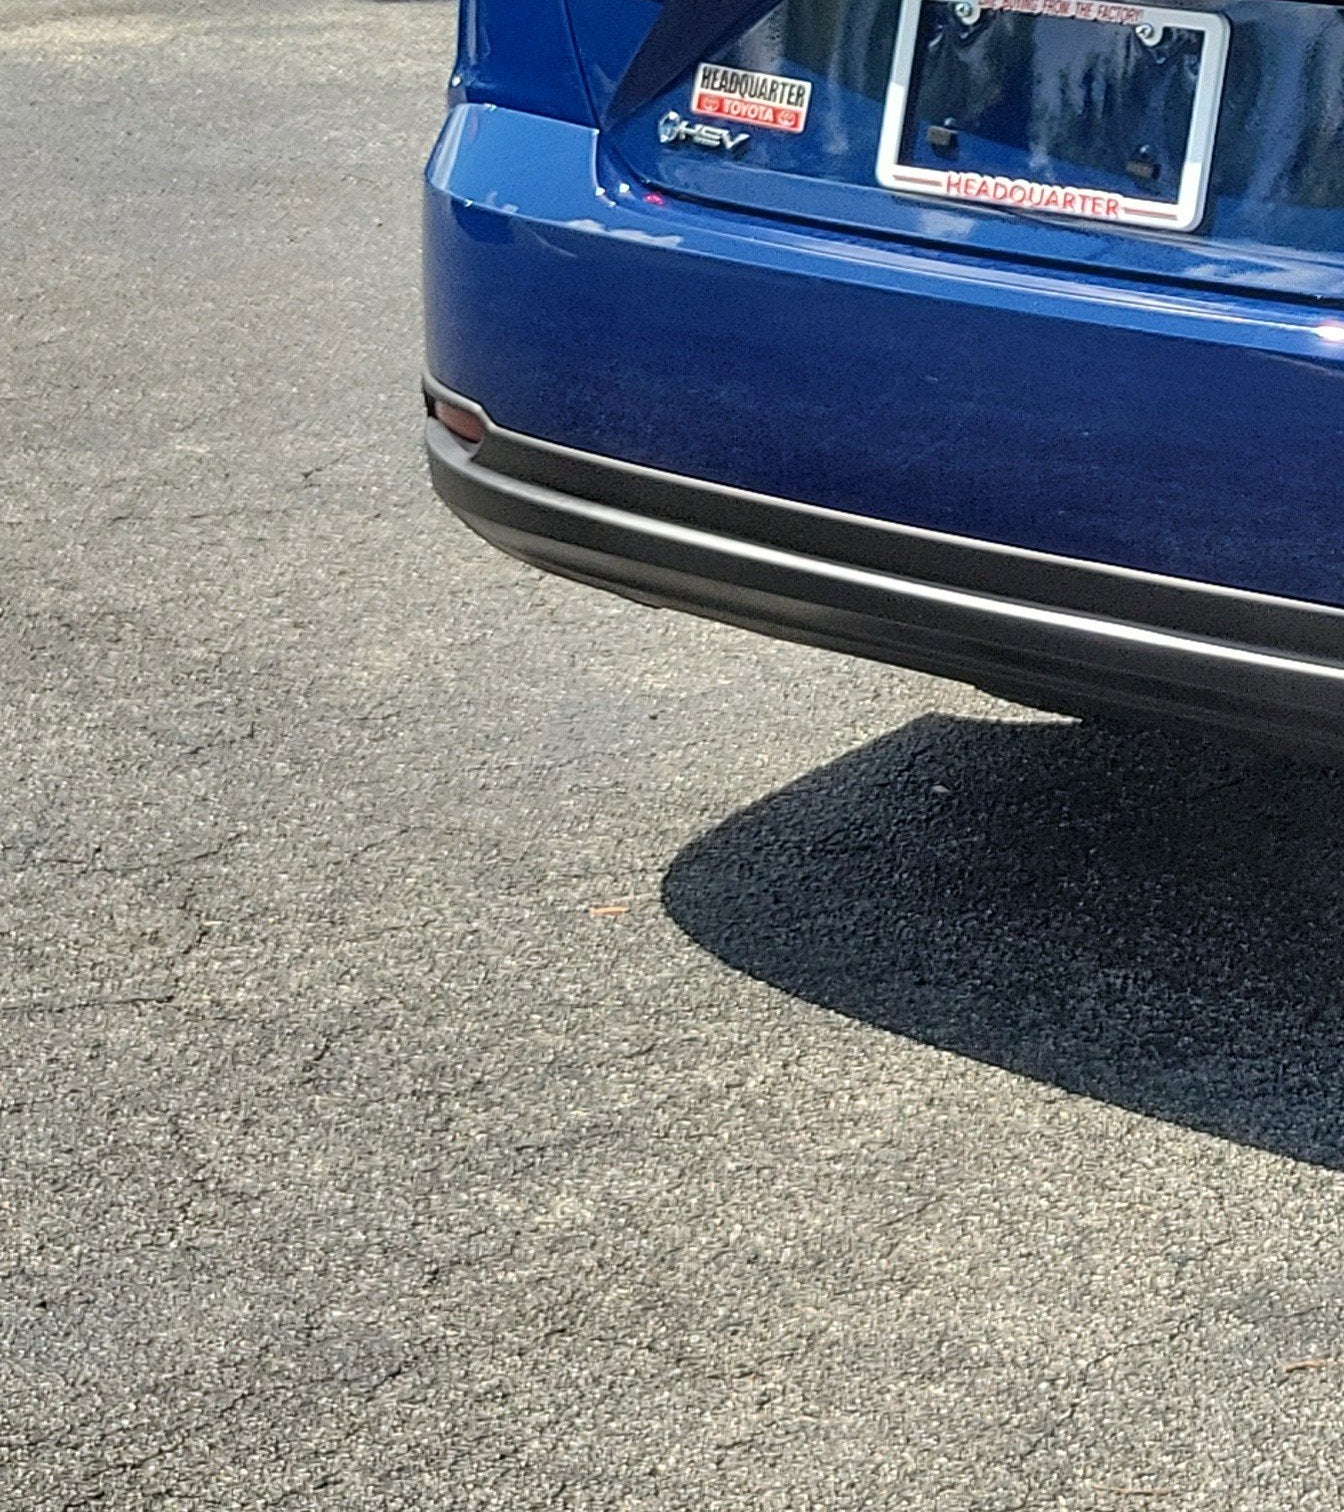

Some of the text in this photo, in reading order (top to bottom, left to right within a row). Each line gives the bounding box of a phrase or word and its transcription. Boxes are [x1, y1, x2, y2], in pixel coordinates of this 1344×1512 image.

[1076, 0, 1094, 18] THE
[701, 66, 807, 108] HEADQUARTER
[722, 98, 776, 123] TOYOTA
[946, 171, 1121, 218] HEADQUARTER
